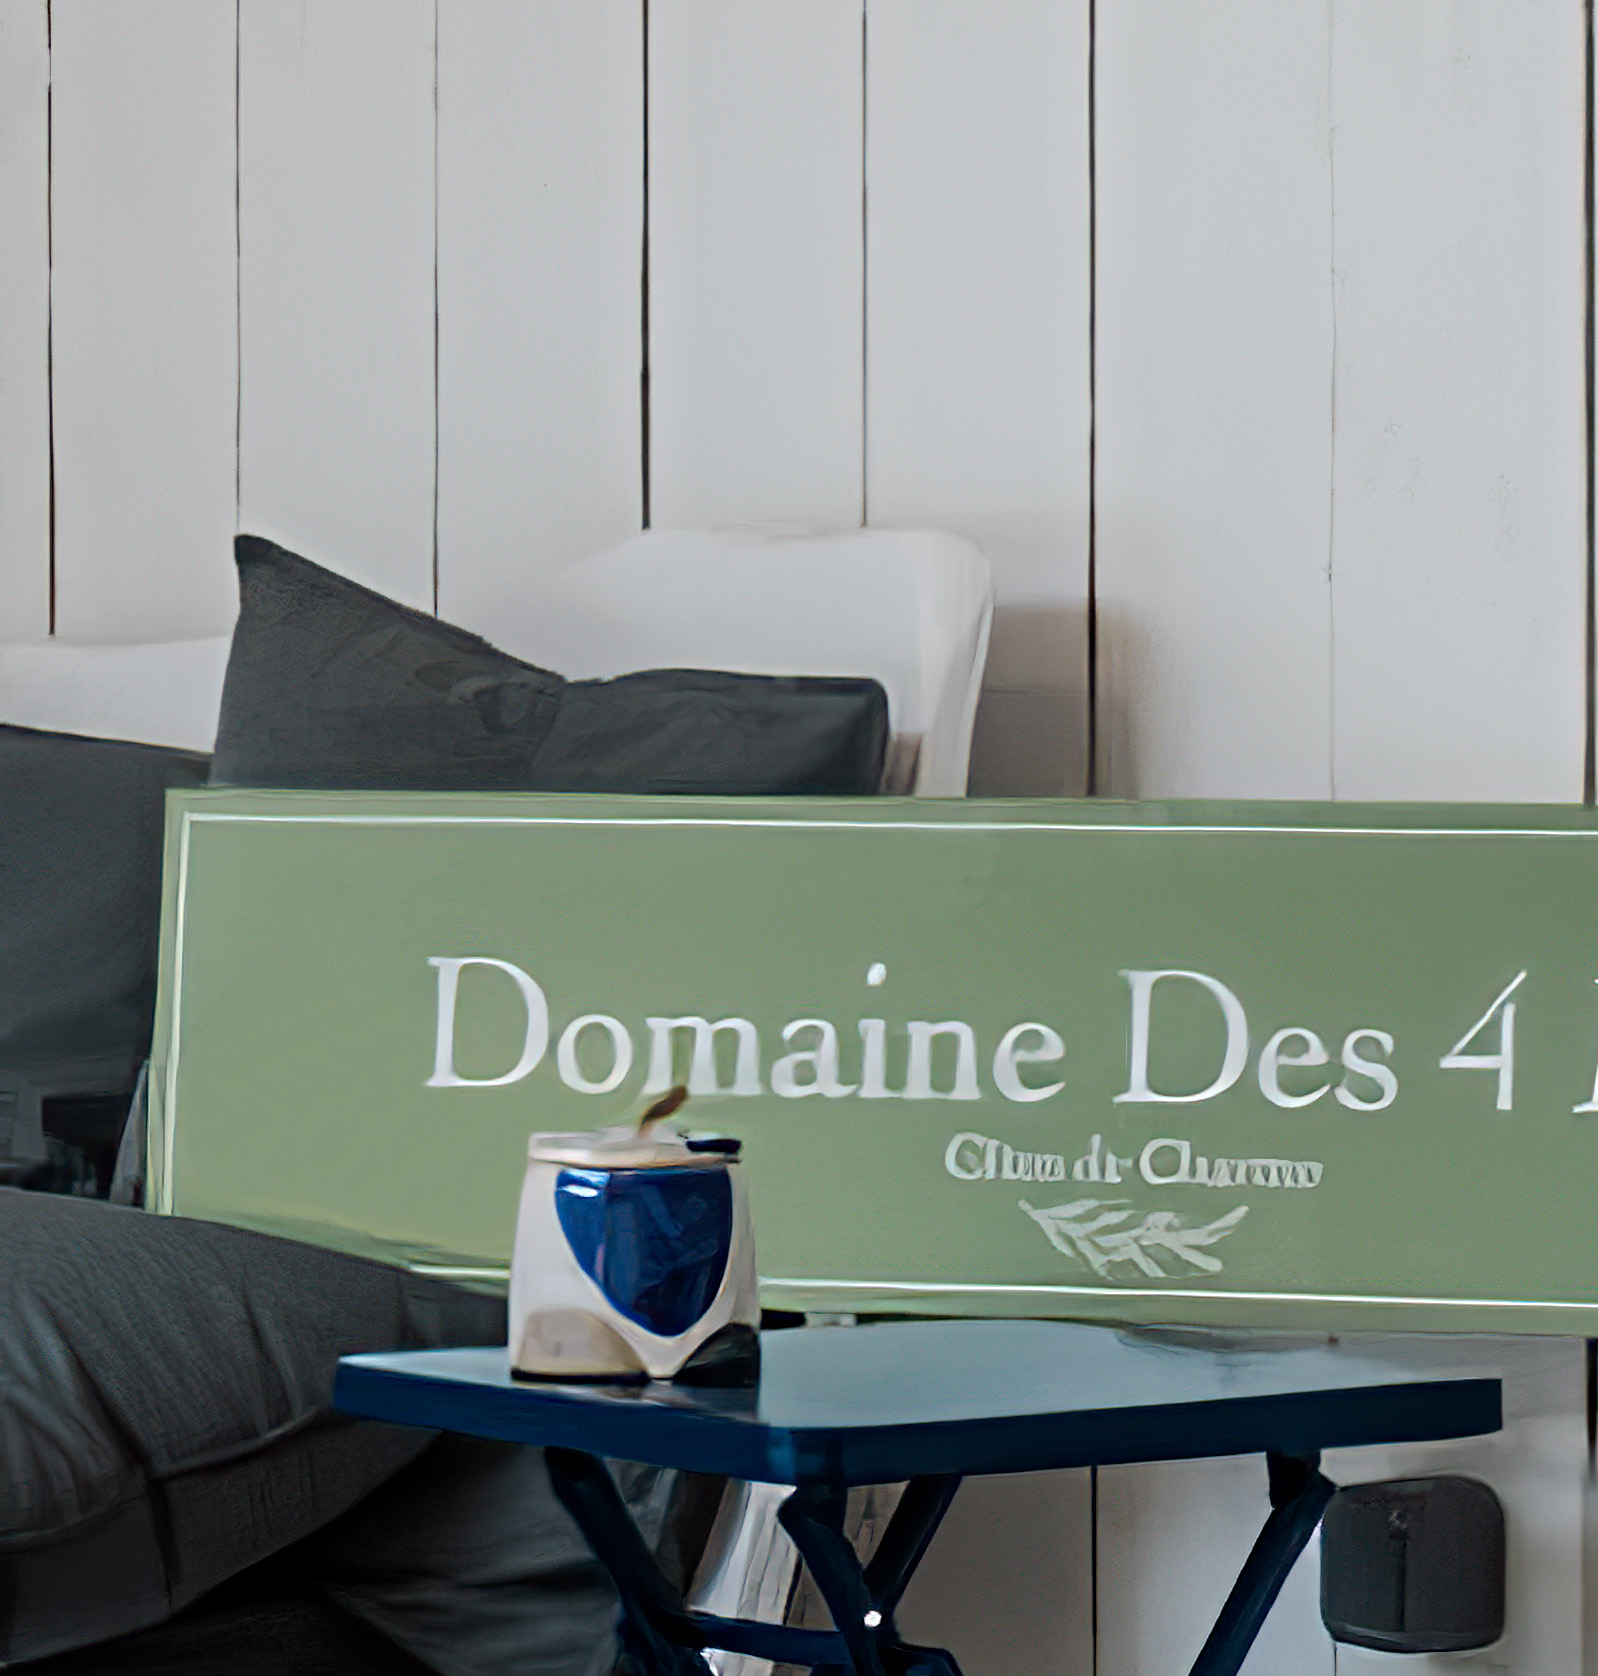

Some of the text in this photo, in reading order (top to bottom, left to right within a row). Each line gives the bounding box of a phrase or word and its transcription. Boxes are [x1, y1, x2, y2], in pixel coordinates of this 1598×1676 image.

[424, 956, 1067, 1102] Domaine
[1112, 967, 1399, 1111] Des
[1438, 968, 1528, 1111] 4
